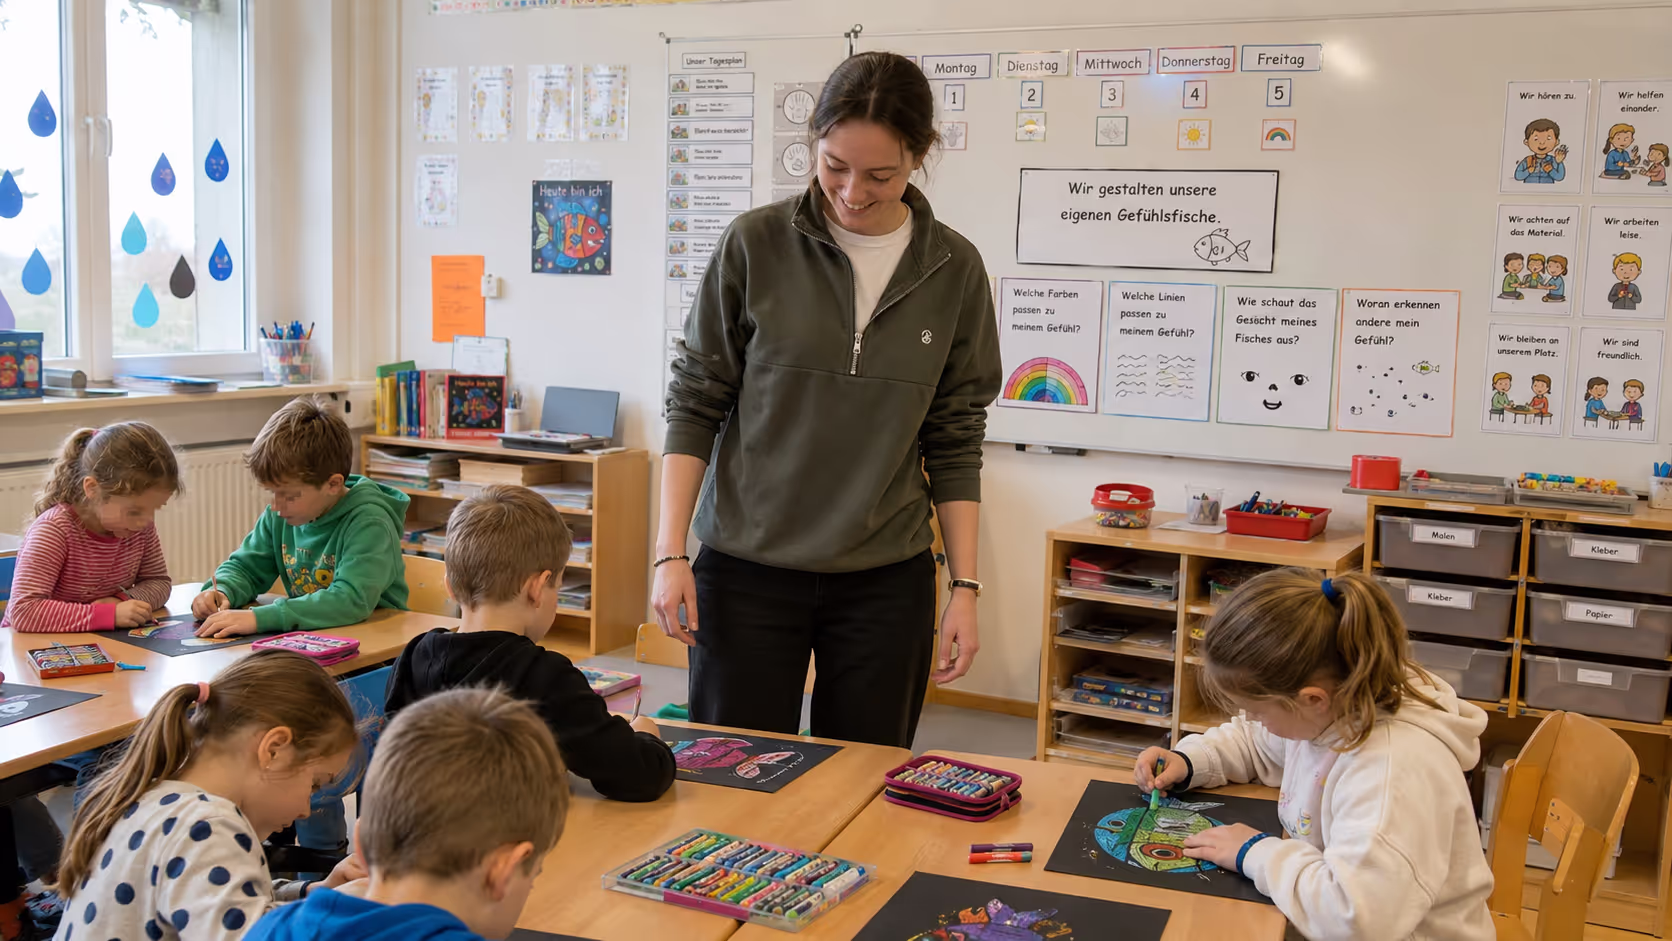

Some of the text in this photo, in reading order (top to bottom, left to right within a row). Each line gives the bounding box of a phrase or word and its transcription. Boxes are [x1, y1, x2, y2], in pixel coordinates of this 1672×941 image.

[708, 56, 743, 67] Tagesplan
[1084, 56, 1142, 70] Mittwoch
[1161, 55, 1231, 70] Donnerstag
[1257, 52, 1305, 69] Freitag
[934, 62, 977, 77] Montag
[1007, 59, 1059, 75] Dienstag
[951, 91, 957, 105] 1
[1027, 87, 1036, 102] 2
[1107, 87, 1117, 102] 3
[1190, 87, 1200, 102] 4
[1274, 85, 1284, 101] 5
[1519, 91, 1535, 100] Wir
[1537, 91, 1562, 100] hören
[1618, 90, 1664, 100] Wir helfen
[540, 185, 602, 196] Heute bin ich
[1067, 181, 1218, 199] Wir gestalten unsere
[1060, 207, 1221, 225] eigenen Gefühlsfische.
[1508, 215, 1571, 225] Wir achten auf
[1604, 217, 1660, 227] Wir arbeiten
[1509, 228, 1566, 237] das Material.
[1619, 230, 1642, 239] leise.
[1012, 288, 1079, 299] Welche Farben
[1121, 291, 1186, 302] Welche Linien
[1237, 296, 1317, 309] Wie schaut das
[1356, 298, 1441, 310] Woran erkennen
[1012, 306, 1056, 316] passen zu
[1120, 310, 1167, 320] passen zu
[1280, 316, 1317, 327] meines
[1355, 316, 1420, 328] andere mein
[1011, 322, 1081, 334] meinem Gefühl?
[1119, 326, 1195, 338] meinem Gefühl?
[1235, 332, 1300, 345] Fisches aus?
[1354, 334, 1395, 346] Gefühl?
[1498, 334, 1514, 342] Wir
[1516, 334, 1547, 344] bleiben
[1602, 337, 1640, 347] Wir sind
[1497, 348, 1559, 358] unserem Platz.
[1597, 350, 1643, 361] freundlich.
[1431, 531, 1456, 541] Malen
[1590, 545, 1619, 556] Kleber
[1427, 592, 1453, 602] Kleber
[1585, 608, 1614, 621] Papier
